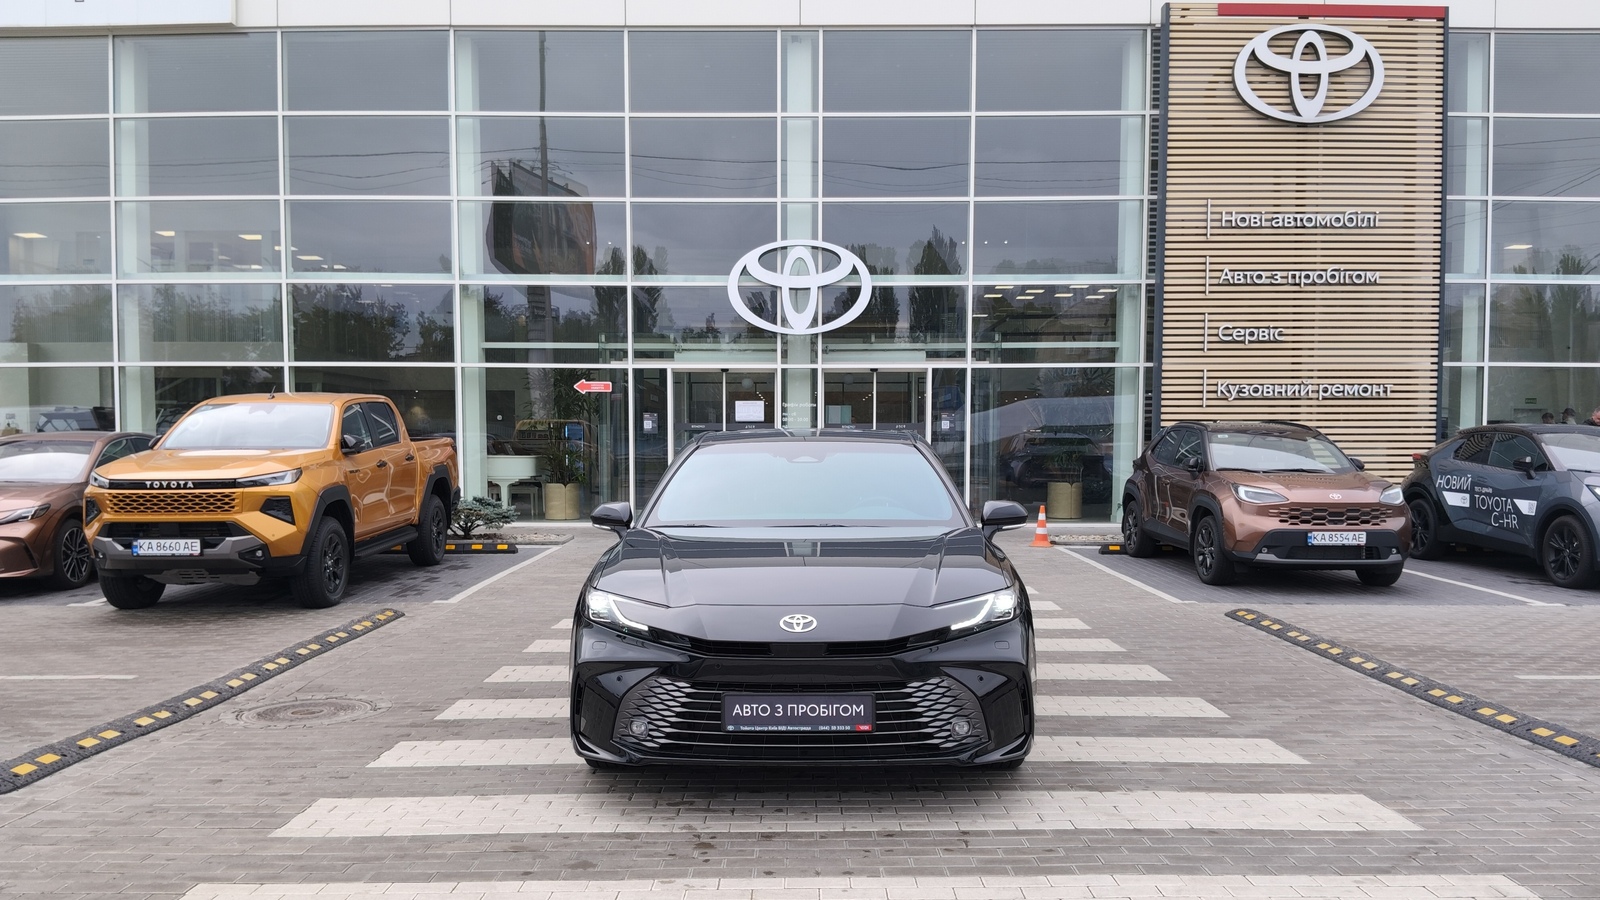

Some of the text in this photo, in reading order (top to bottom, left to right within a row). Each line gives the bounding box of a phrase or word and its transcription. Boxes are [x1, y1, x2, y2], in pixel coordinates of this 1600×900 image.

[1221, 210, 1380, 228] Нові автомобілі
[1219, 267, 1380, 288] Авто з пробігом
[1217, 325, 1285, 345] Сервіс
[1217, 380, 1394, 401] Кузовний ремонт
[1436, 474, 1472, 491] НОВИЙ
[1474, 494, 1514, 513] TOYOTA
[1491, 512, 1519, 529] C-HR
[155, 541, 181, 552] 8660
[1328, 534, 1350, 542] 8554
[732, 704, 771, 717] АВТО
[787, 704, 864, 717] ПРОБІГОМ
